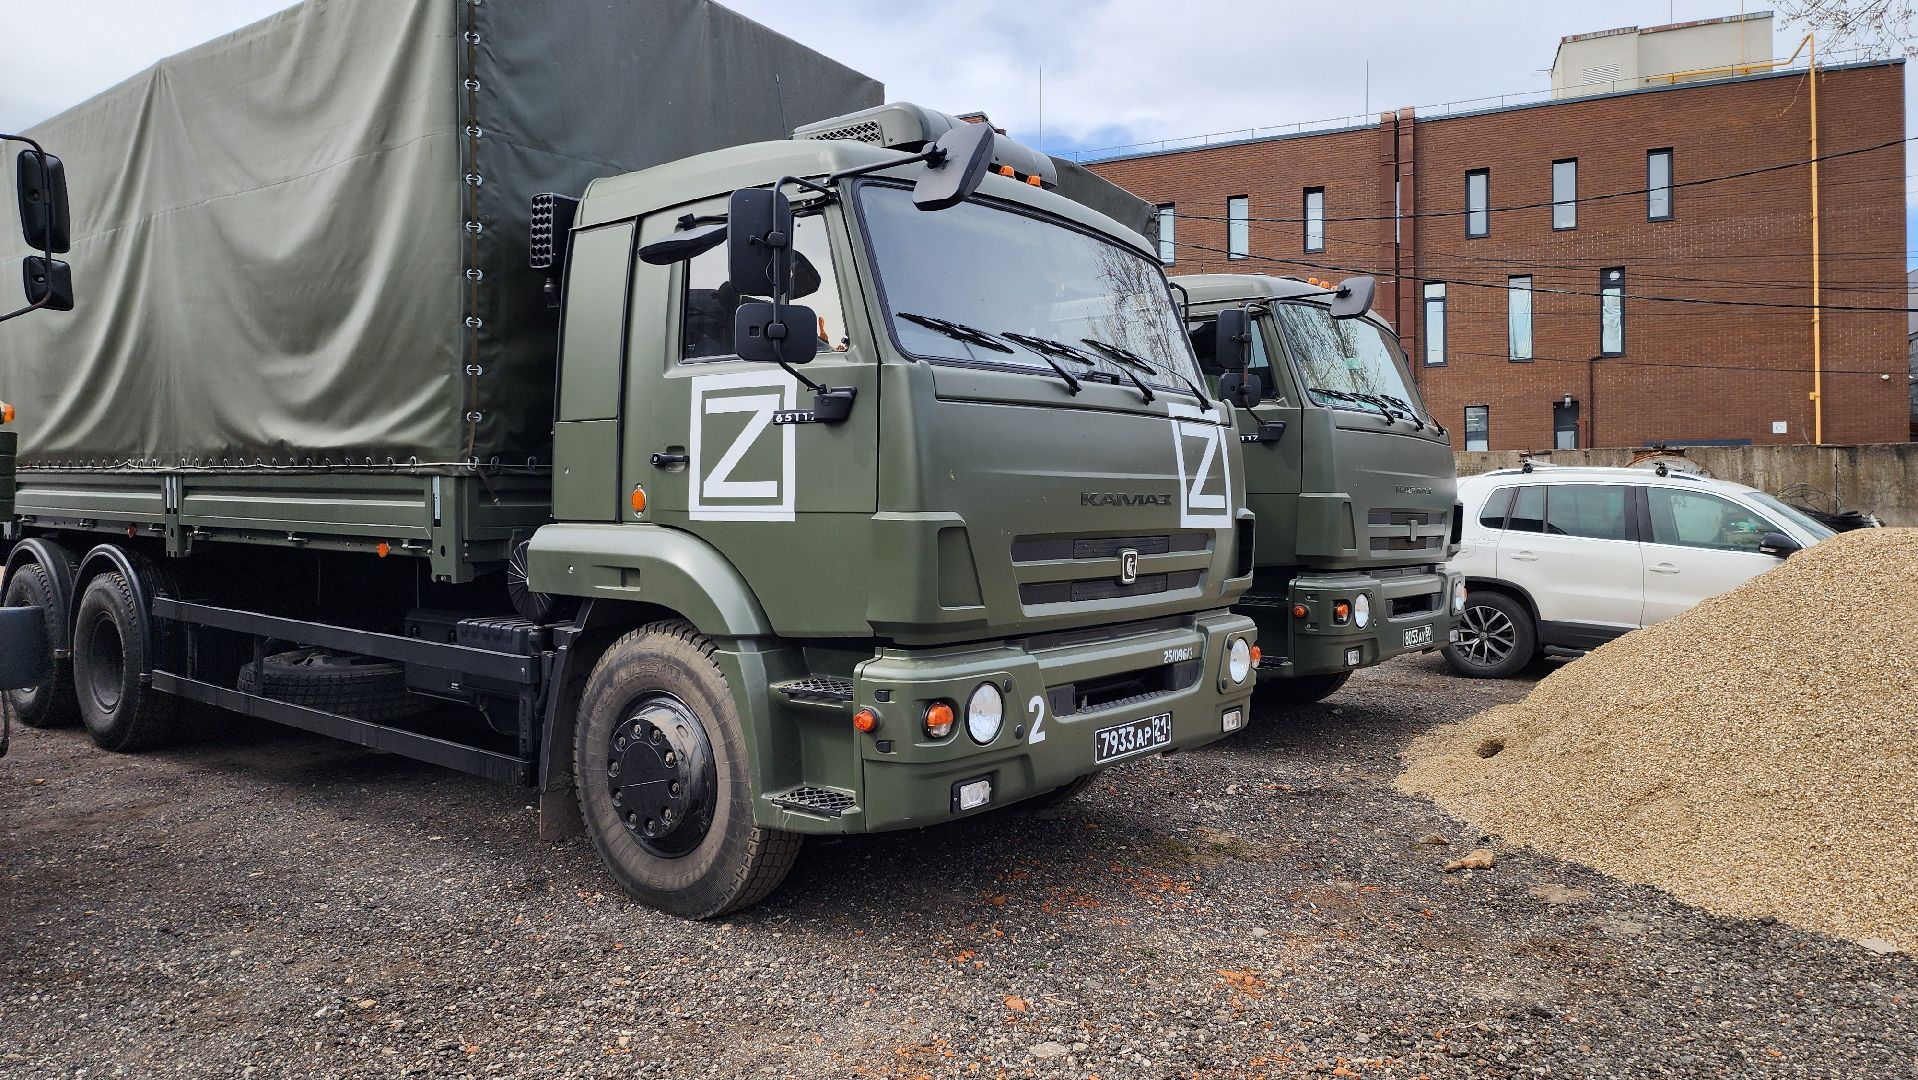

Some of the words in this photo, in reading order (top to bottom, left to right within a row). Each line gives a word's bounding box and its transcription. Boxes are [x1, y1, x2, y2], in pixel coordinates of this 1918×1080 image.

[703, 394, 780, 498] Z
[1178, 422, 1226, 509] Z
[1028, 695, 1046, 745] 2
[1154, 716, 1167, 737] 21
